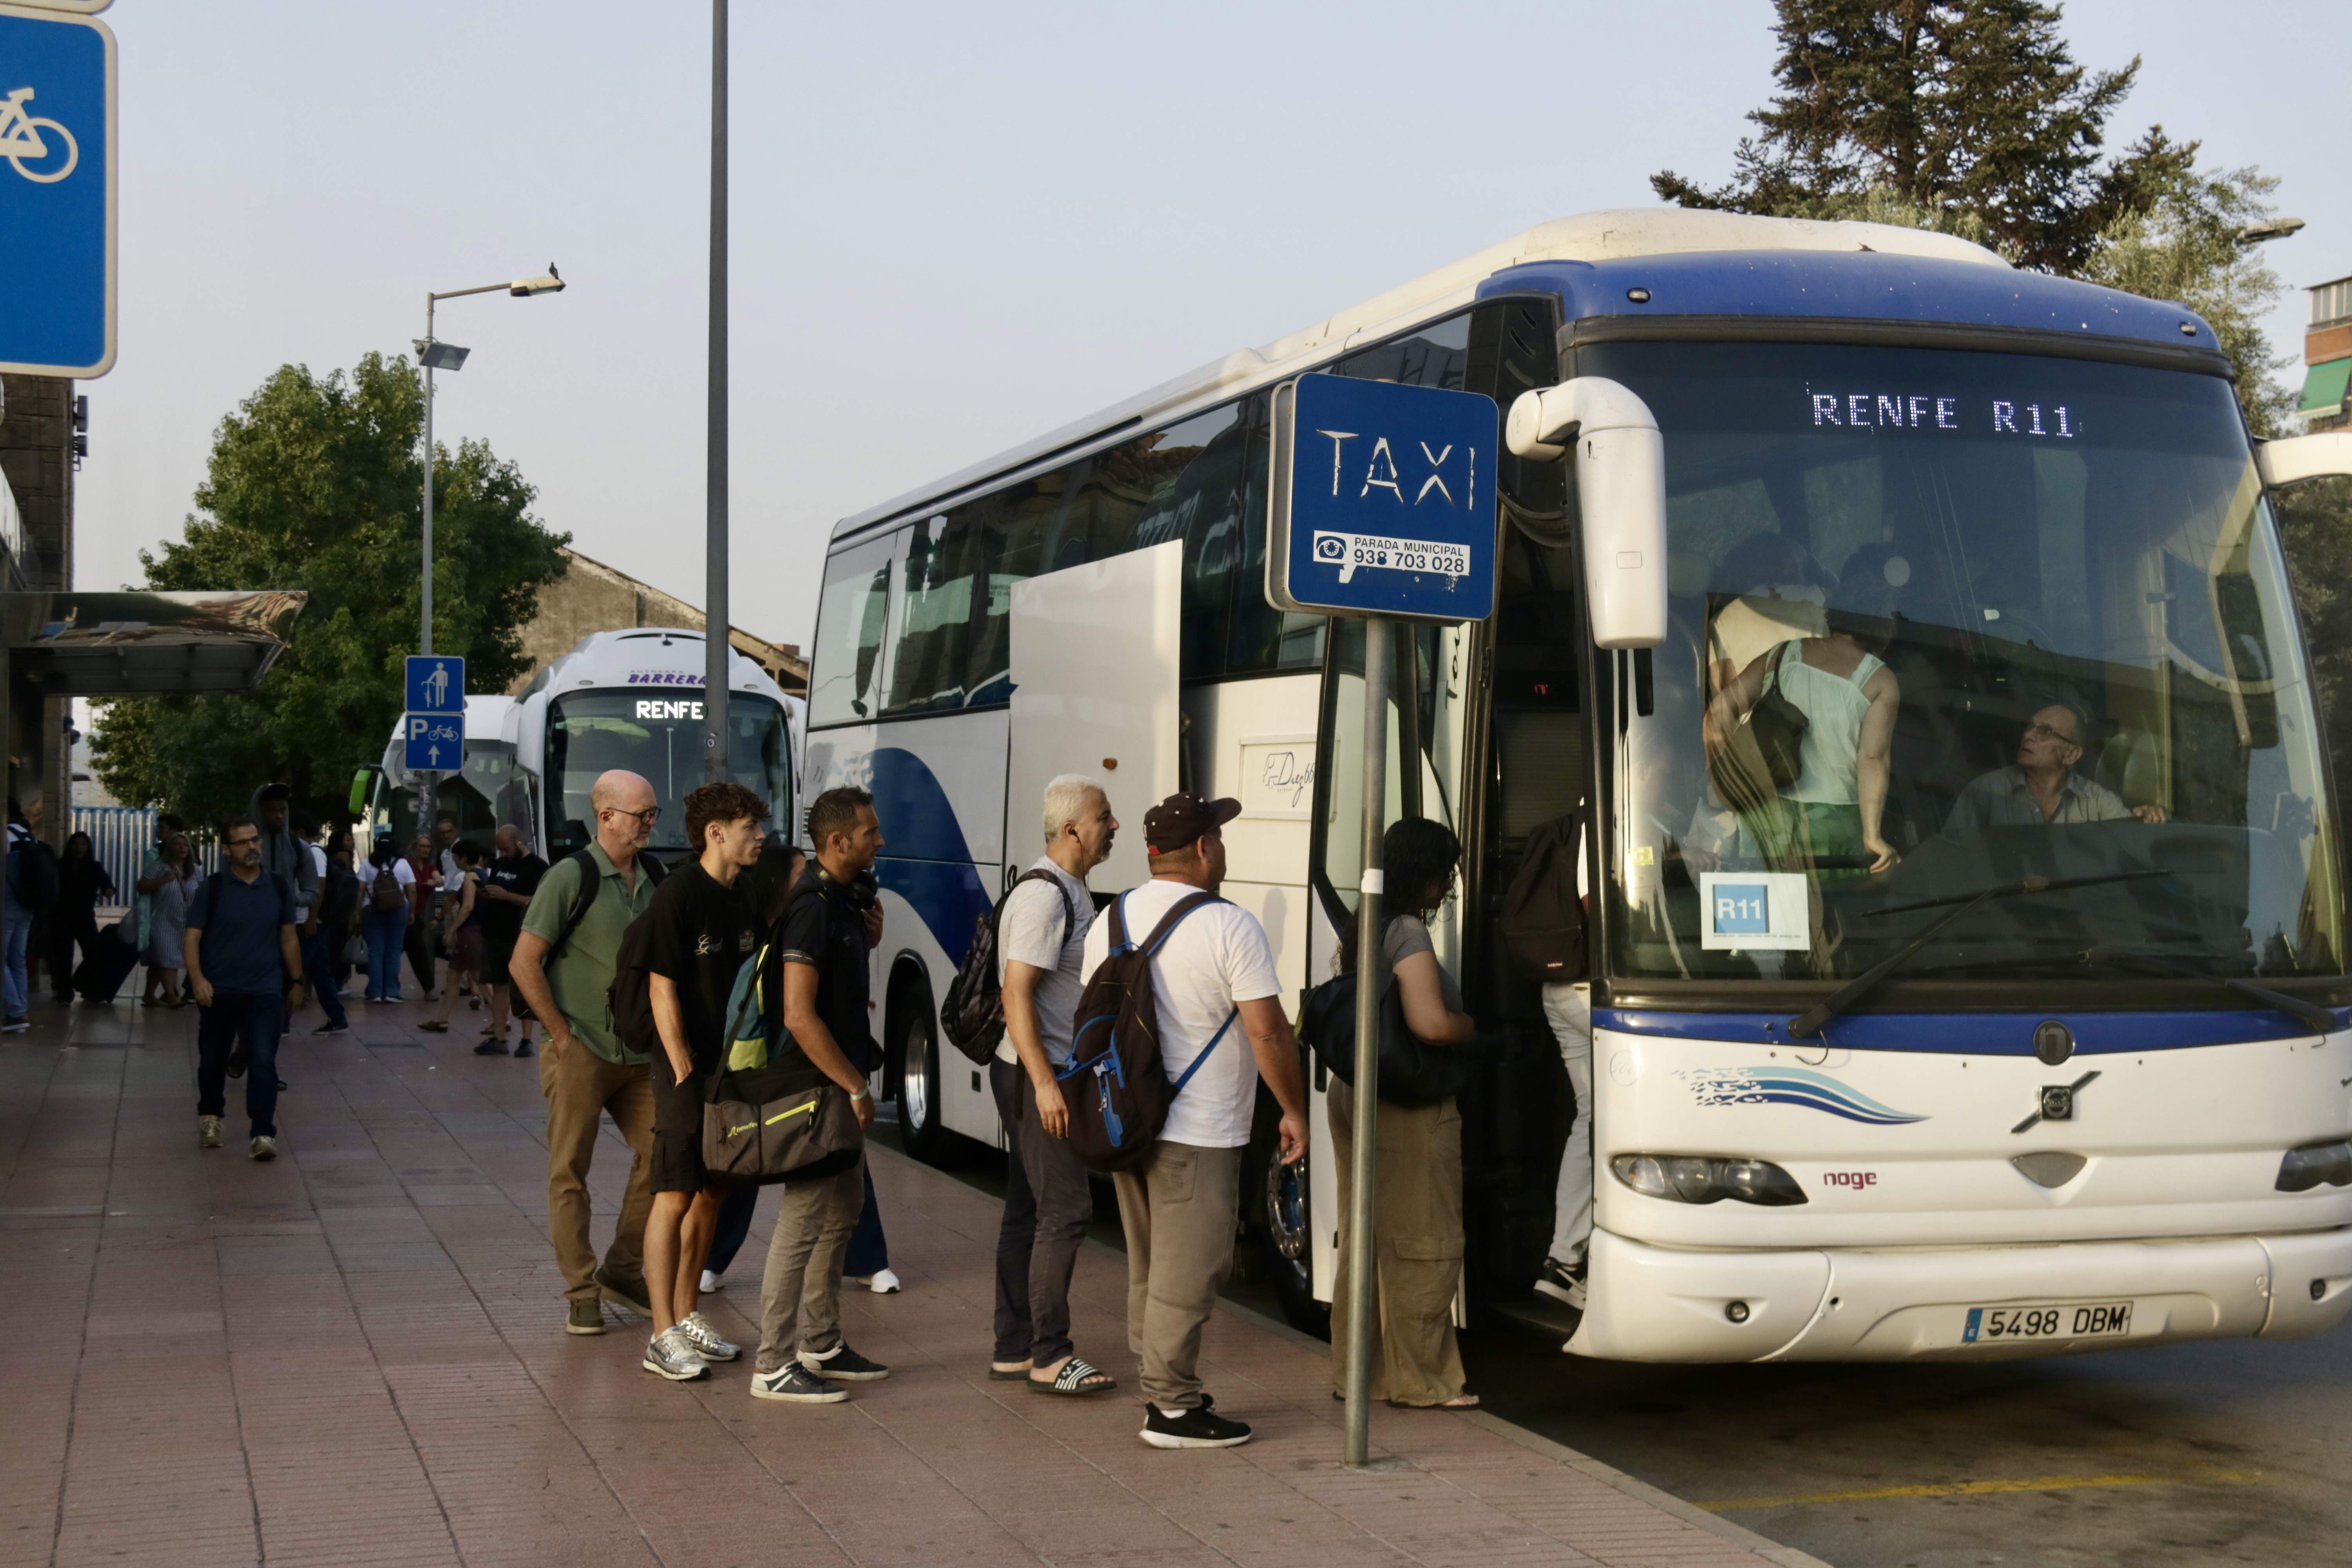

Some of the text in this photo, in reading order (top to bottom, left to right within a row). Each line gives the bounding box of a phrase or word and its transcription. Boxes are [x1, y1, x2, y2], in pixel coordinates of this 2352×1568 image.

[1813, 395, 2073, 437] RENFE R11
[1316, 428, 1475, 510] TAXI
[1354, 537, 1464, 557] PARADA MUNICIPAL
[1354, 549, 1464, 573] 938 703 028
[628, 673, 706, 685] BARRERA
[636, 701, 704, 720] RENFE
[410, 719, 428, 740] P
[1717, 898, 1761, 919] R11
[1824, 1172, 1877, 1190] noge
[1987, 1310, 2059, 1337] 5498
[2072, 1306, 2126, 1335] DBM
